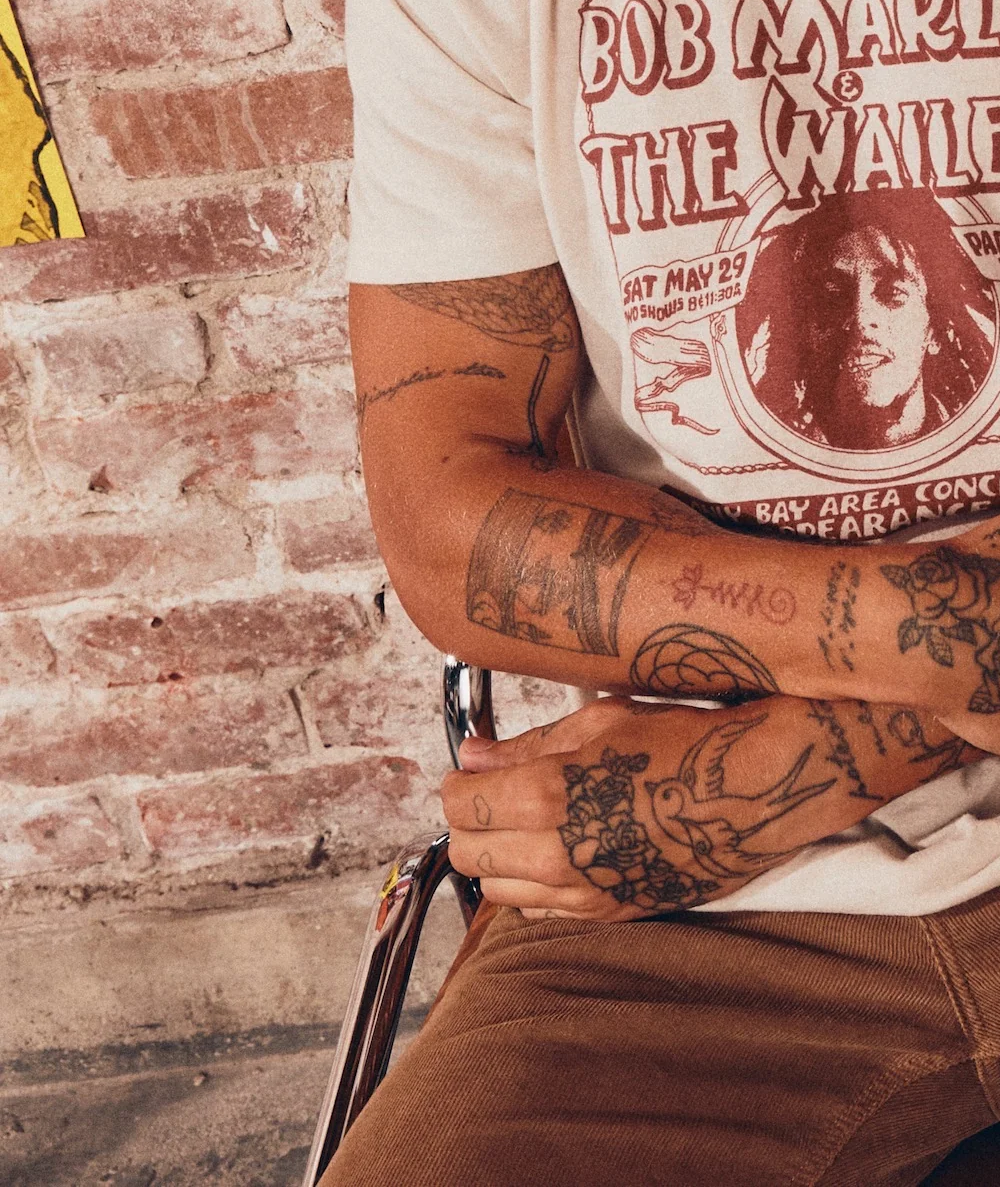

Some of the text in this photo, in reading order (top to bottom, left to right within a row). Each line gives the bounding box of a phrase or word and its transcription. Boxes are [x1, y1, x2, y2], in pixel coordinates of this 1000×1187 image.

[580, 118, 750, 234] THE
[623, 275, 658, 306] SAT
[664, 262, 713, 297] MAY
[718, 251, 748, 284] 29
[641, 297, 684, 322] SHOWS
[755, 499, 809, 527] BAY
[819, 488, 900, 517] AREA
